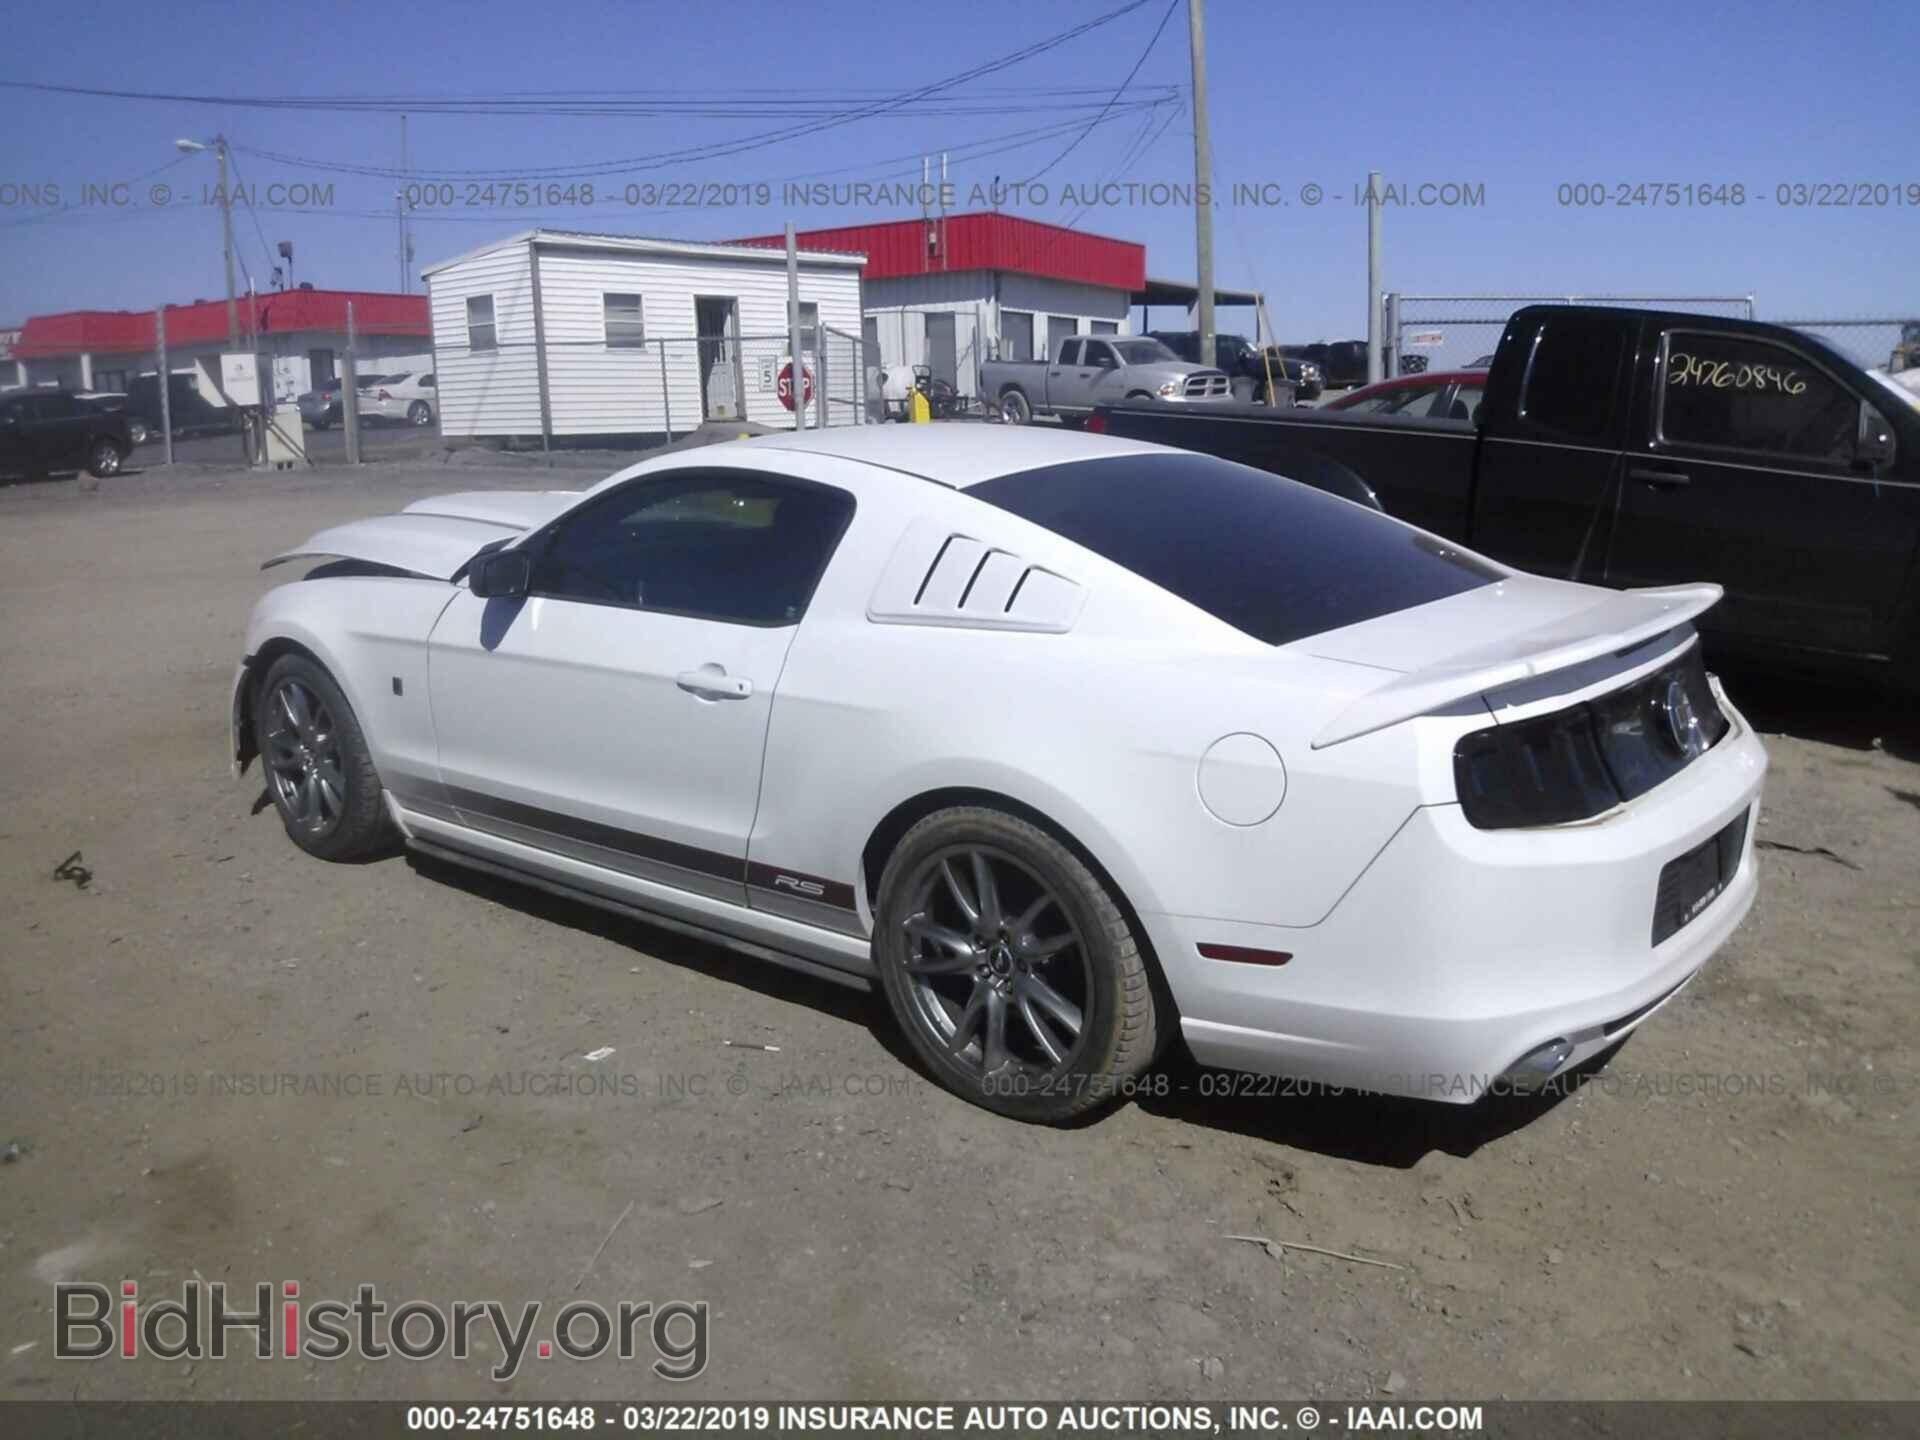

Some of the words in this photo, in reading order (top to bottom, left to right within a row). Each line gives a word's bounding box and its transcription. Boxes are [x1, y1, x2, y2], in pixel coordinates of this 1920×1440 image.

[763, 370, 772, 383] 5
[1670, 353, 1806, 394] 24760846
[779, 378, 811, 397] STP
[775, 874, 825, 895] RS
